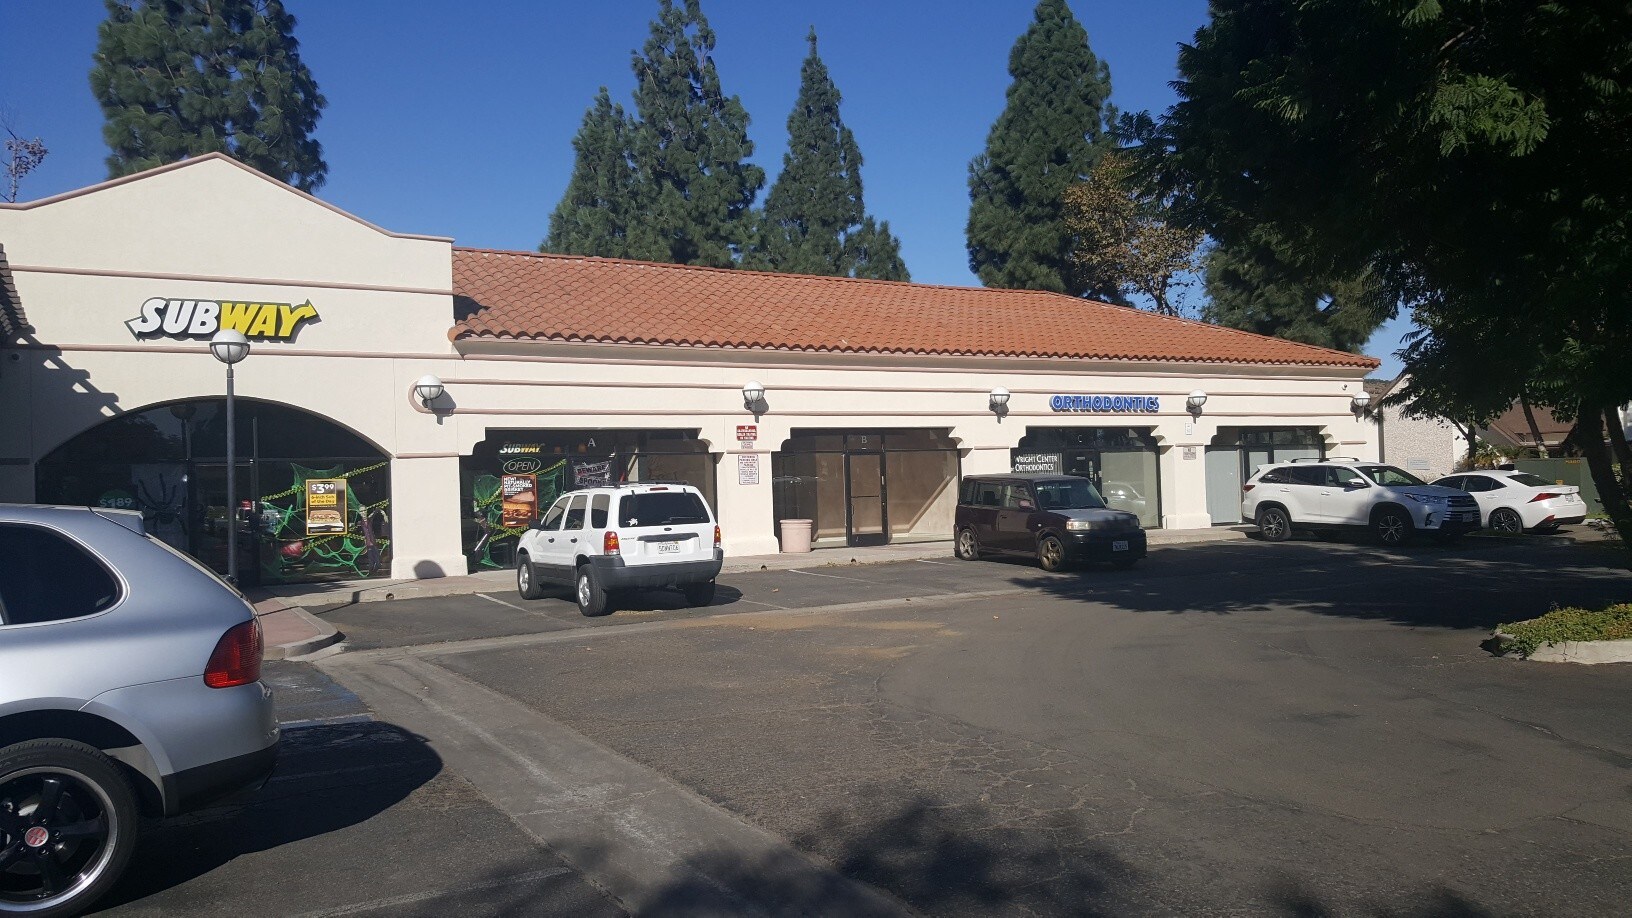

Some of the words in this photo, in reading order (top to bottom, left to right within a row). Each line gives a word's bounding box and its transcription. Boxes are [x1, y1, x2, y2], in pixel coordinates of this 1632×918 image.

[127, 298, 318, 340] SUBWAY
[1050, 394, 1160, 412] ORTHODONTICS
[587, 437, 597, 447] A
[861, 435, 868, 444] B
[498, 442, 546, 454] SUBWAY
[1036, 454, 1059, 463] CENTER
[508, 461, 536, 471] OPEN
[1014, 463, 1054, 472] ORTHODONTICS
